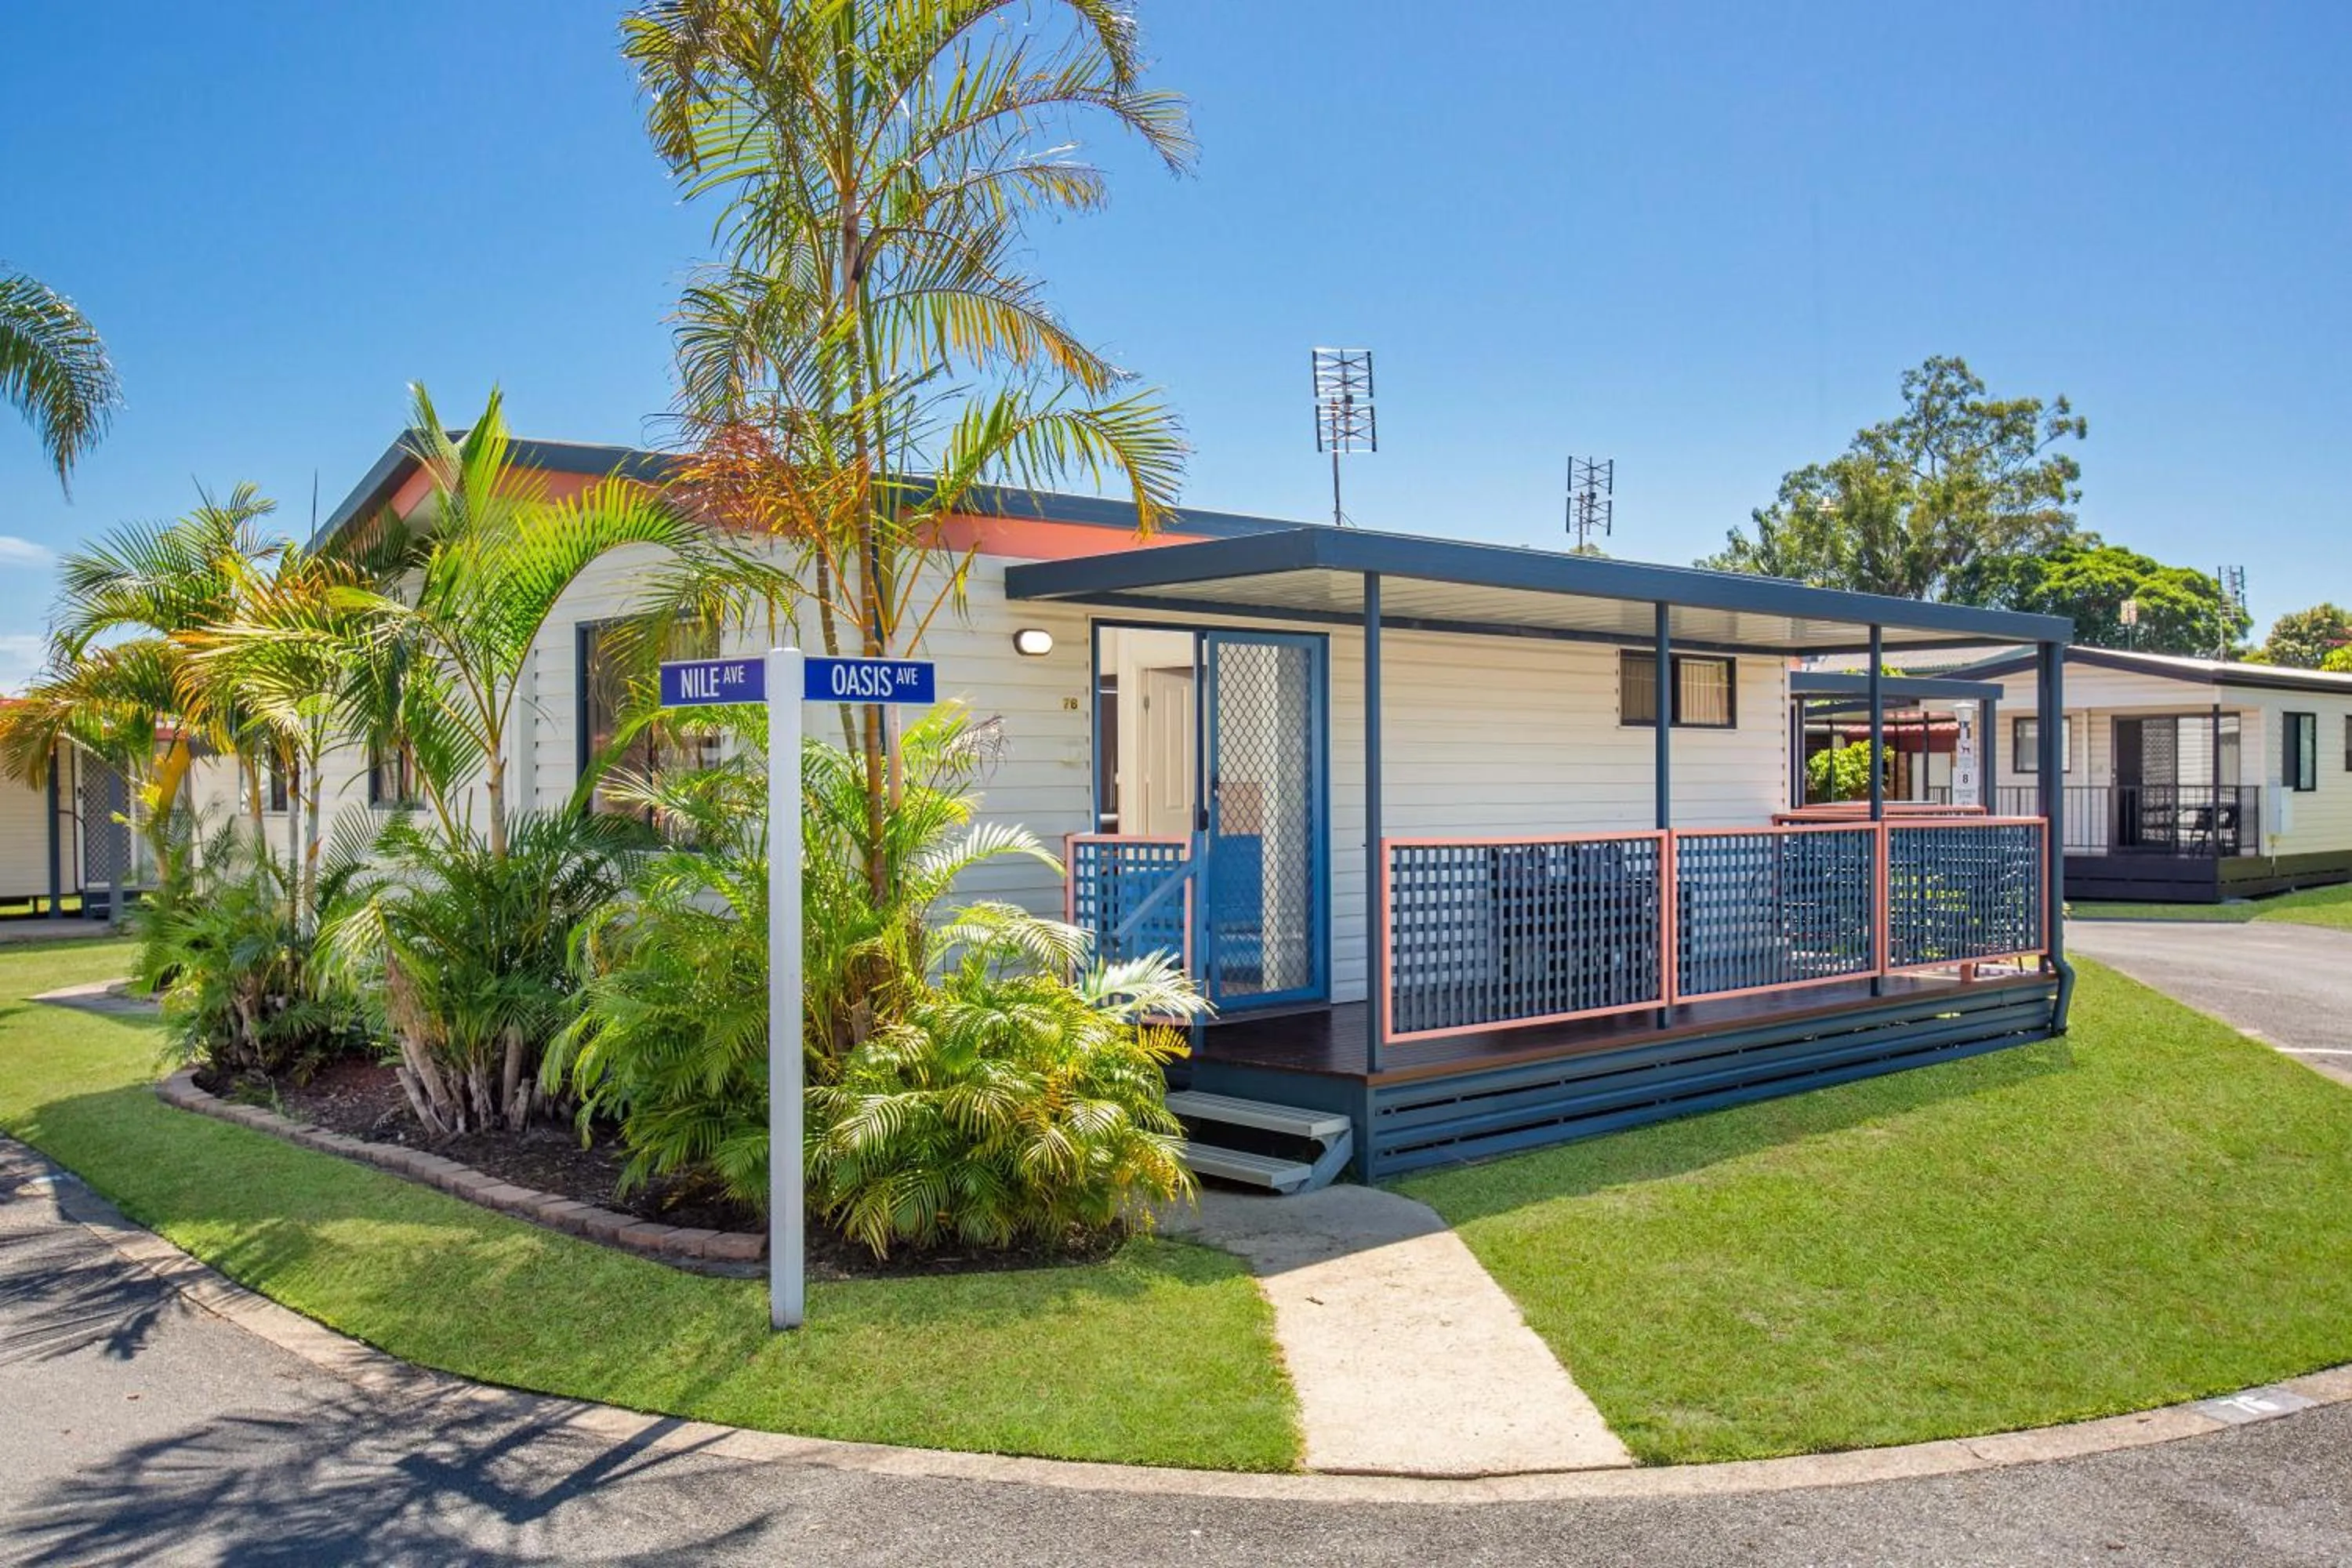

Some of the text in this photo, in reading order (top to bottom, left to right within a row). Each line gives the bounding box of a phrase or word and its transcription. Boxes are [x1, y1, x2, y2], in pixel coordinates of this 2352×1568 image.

[681, 665, 744, 699] NILE AVE
[831, 665, 918, 696] OASIS AVE
[1962, 774, 1969, 784] 8
